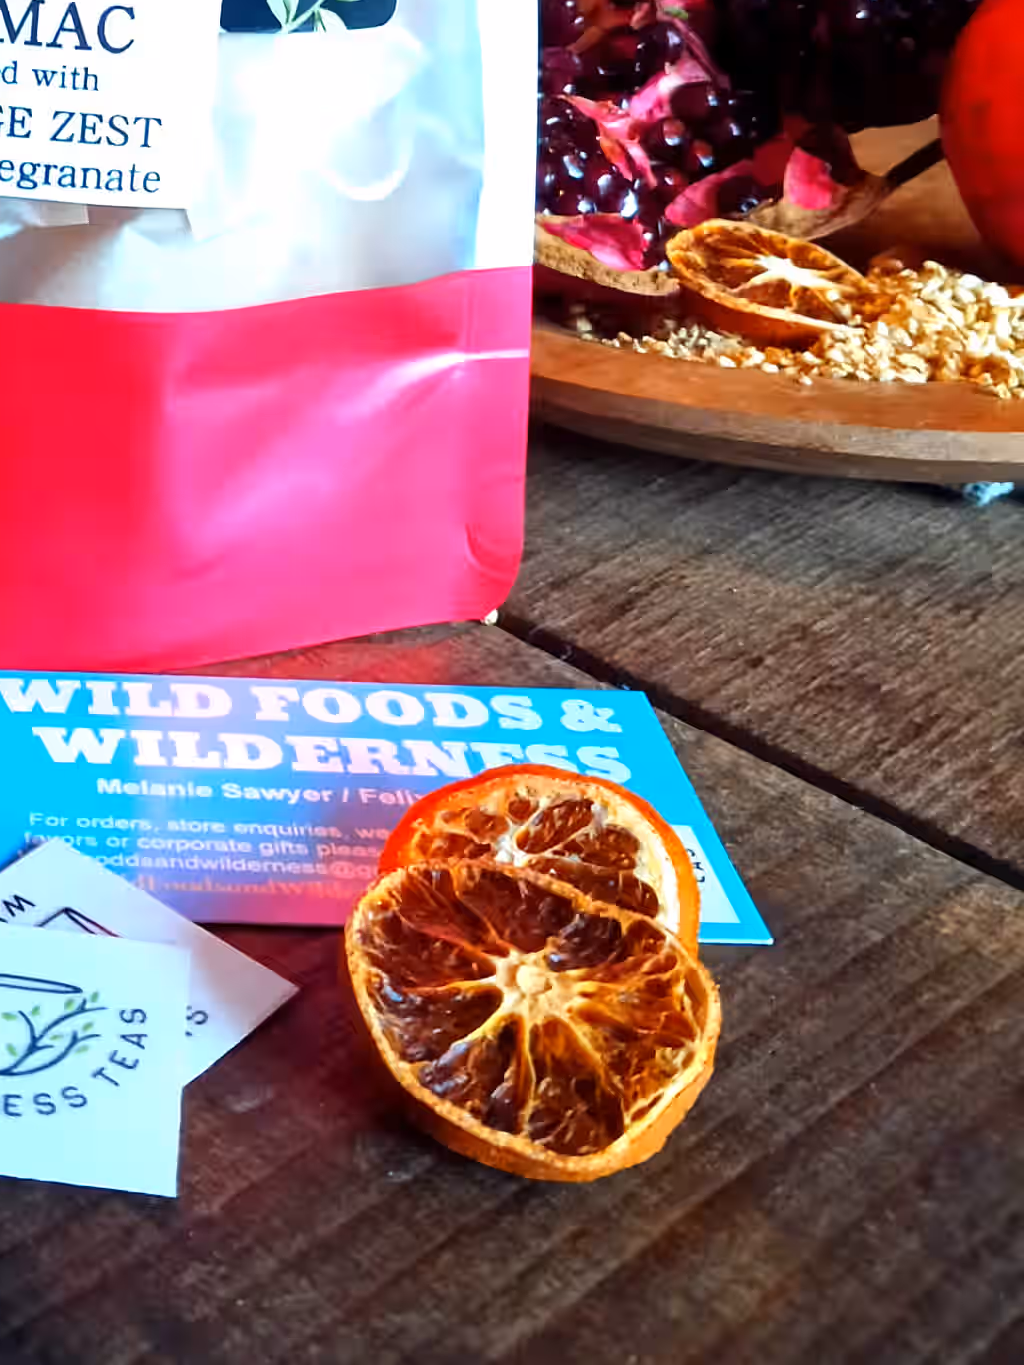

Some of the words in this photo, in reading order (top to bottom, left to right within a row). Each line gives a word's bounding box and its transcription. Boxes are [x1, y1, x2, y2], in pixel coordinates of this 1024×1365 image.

[32, 63, 100, 92] with
[49, 110, 163, 149] ZEST
[251, 685, 543, 730] FOODS
[560, 699, 623, 733] &
[31, 726, 632, 784] WILDERNESS
[97, 777, 213, 798] Melanie
[221, 783, 332, 805] Sawyer
[29, 812, 69, 827] For
[167, 819, 225, 834] store
[106, 837, 130, 848] or
[137, 837, 252, 853] corporate
[259, 840, 309, 857] gifts
[92, 1007, 147, 1087] TEAS
